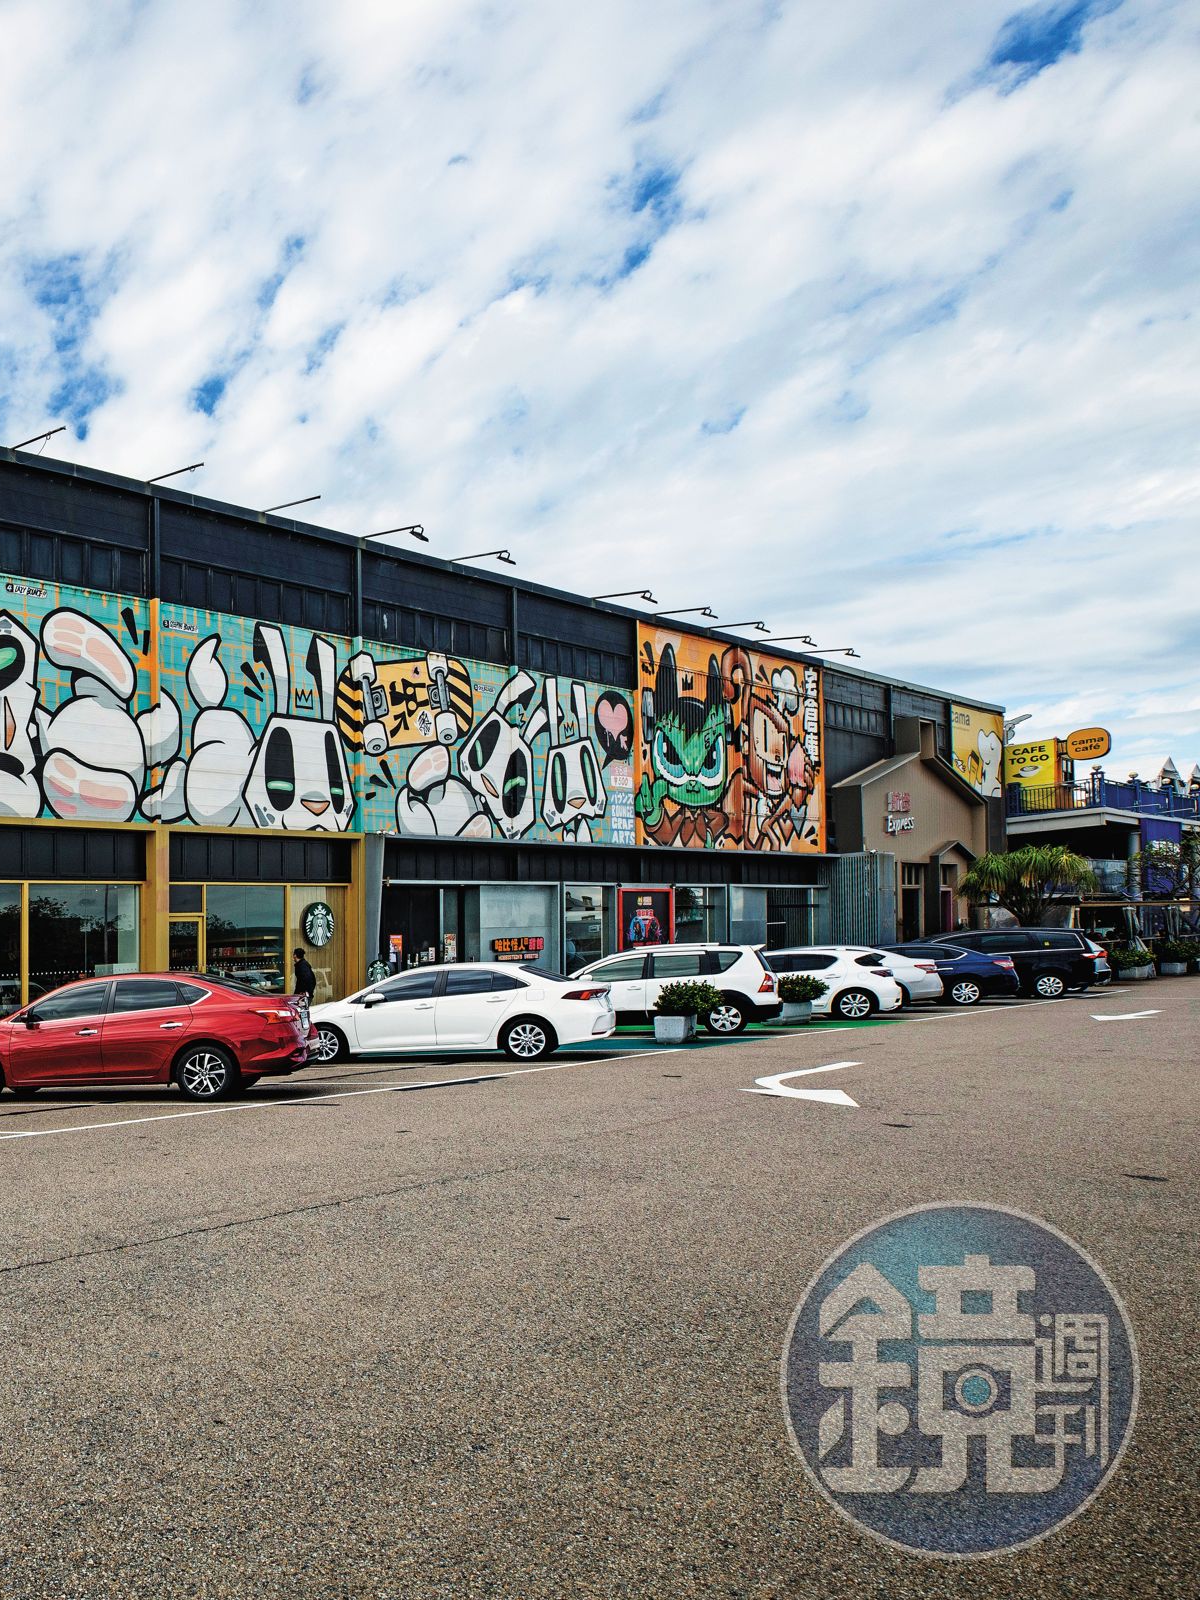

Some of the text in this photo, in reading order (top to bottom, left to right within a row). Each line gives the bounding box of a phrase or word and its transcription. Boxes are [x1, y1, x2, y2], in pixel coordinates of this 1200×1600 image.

[1071, 736, 1104, 746] cama
[1012, 745, 1046, 756] CAFE
[1074, 743, 1101, 753] café
[1009, 754, 1050, 765] TO GO
[612, 830, 635, 845] ARTS
